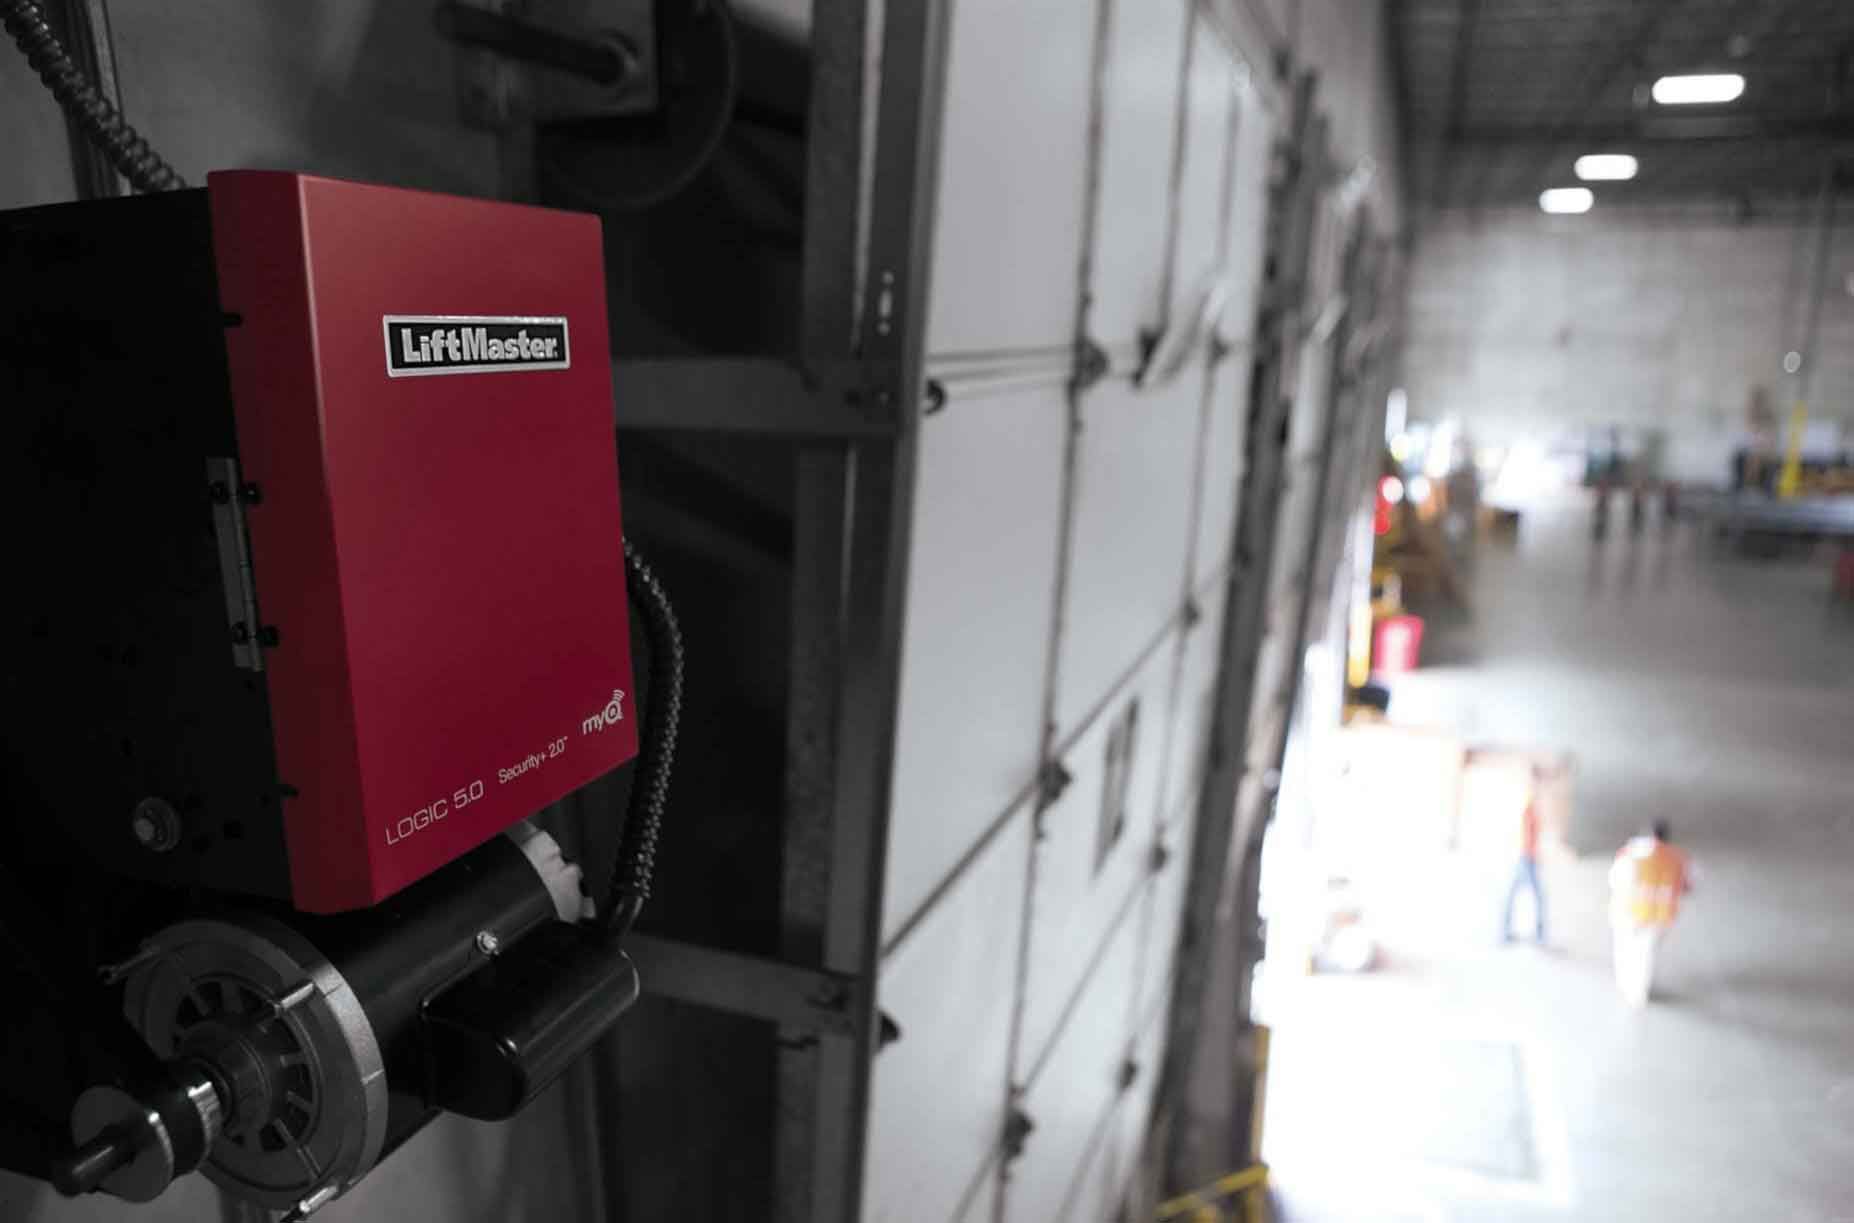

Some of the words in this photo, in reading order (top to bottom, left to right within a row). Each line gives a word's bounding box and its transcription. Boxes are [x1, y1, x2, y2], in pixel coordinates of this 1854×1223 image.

[401, 327, 558, 362] LiftMaster
[582, 699, 624, 735] myQ
[498, 752, 547, 784] Security+
[385, 799, 448, 845] LOGIC
[452, 779, 484, 809] 5.0
